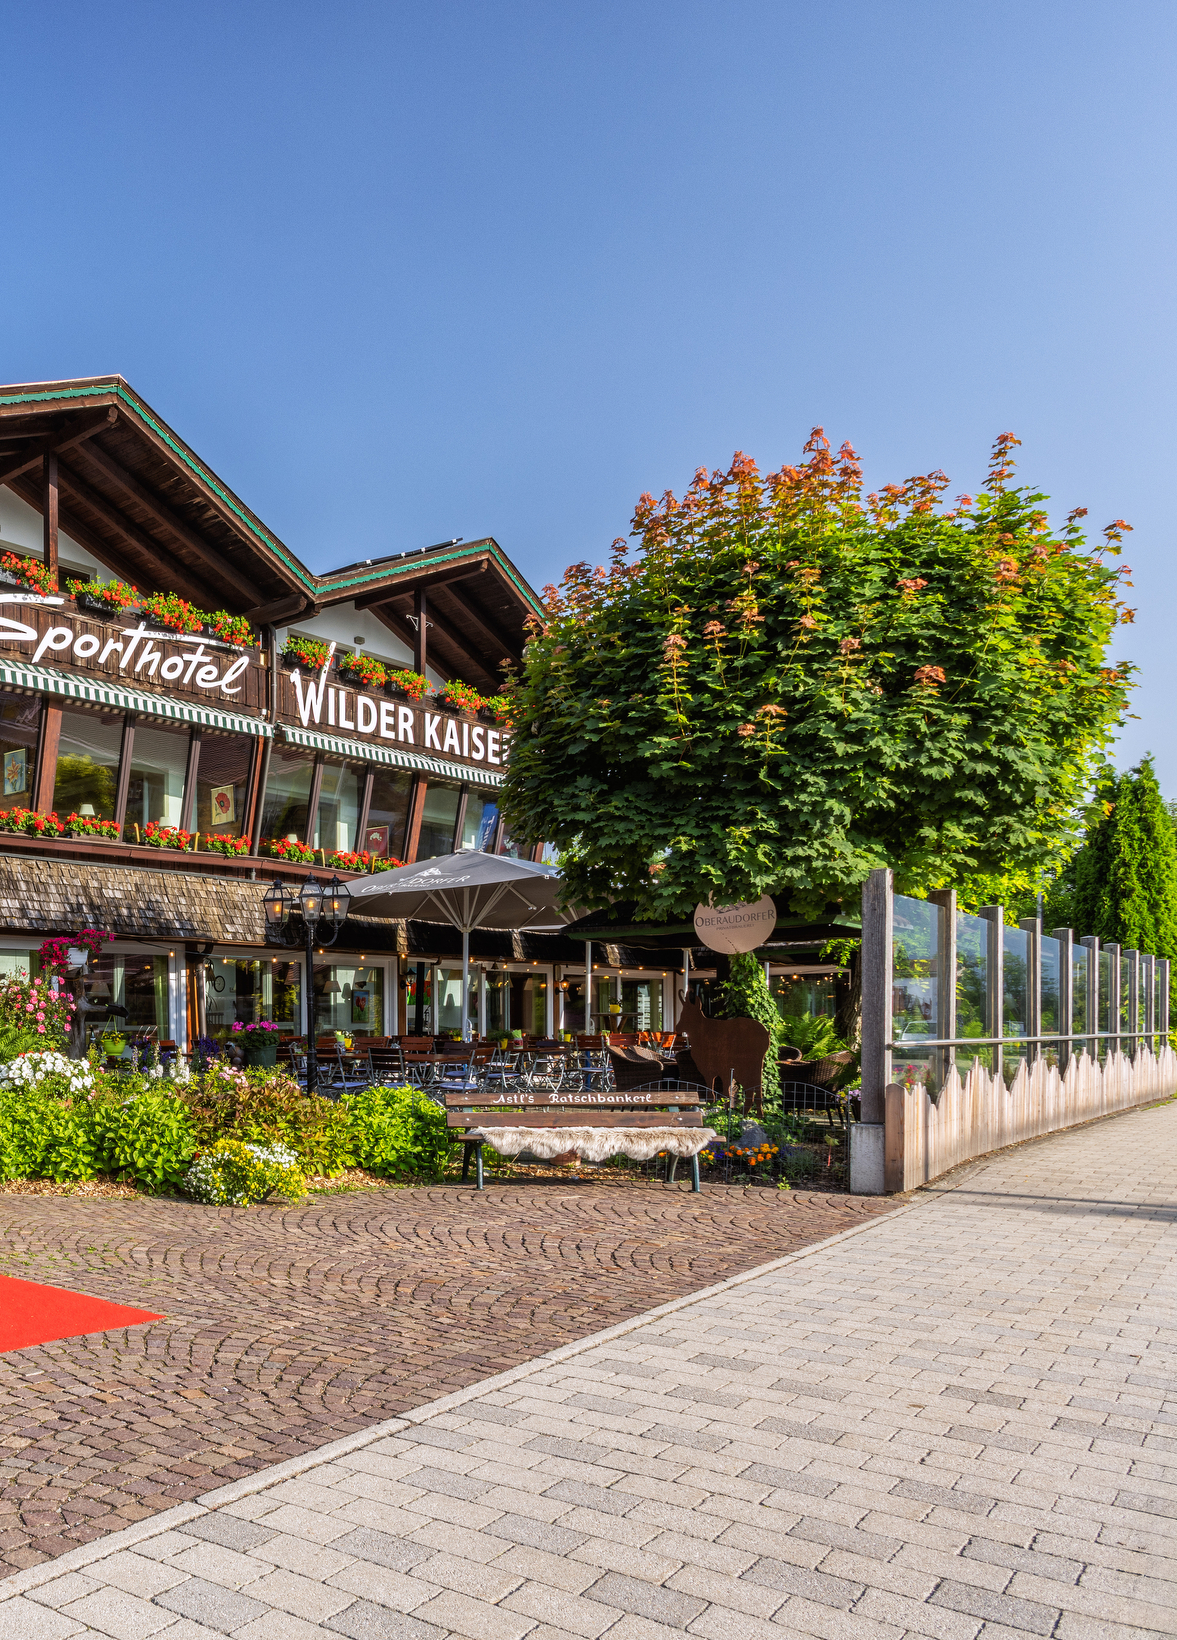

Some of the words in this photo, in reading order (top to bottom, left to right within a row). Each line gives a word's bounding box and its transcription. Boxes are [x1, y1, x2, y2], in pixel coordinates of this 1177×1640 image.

[289, 641, 415, 745] WILDER
[695, 909, 775, 928] OBERAUDORFER
[493, 1093, 535, 1104] Astl's
[548, 1093, 652, 1104] Ratschbankerl
